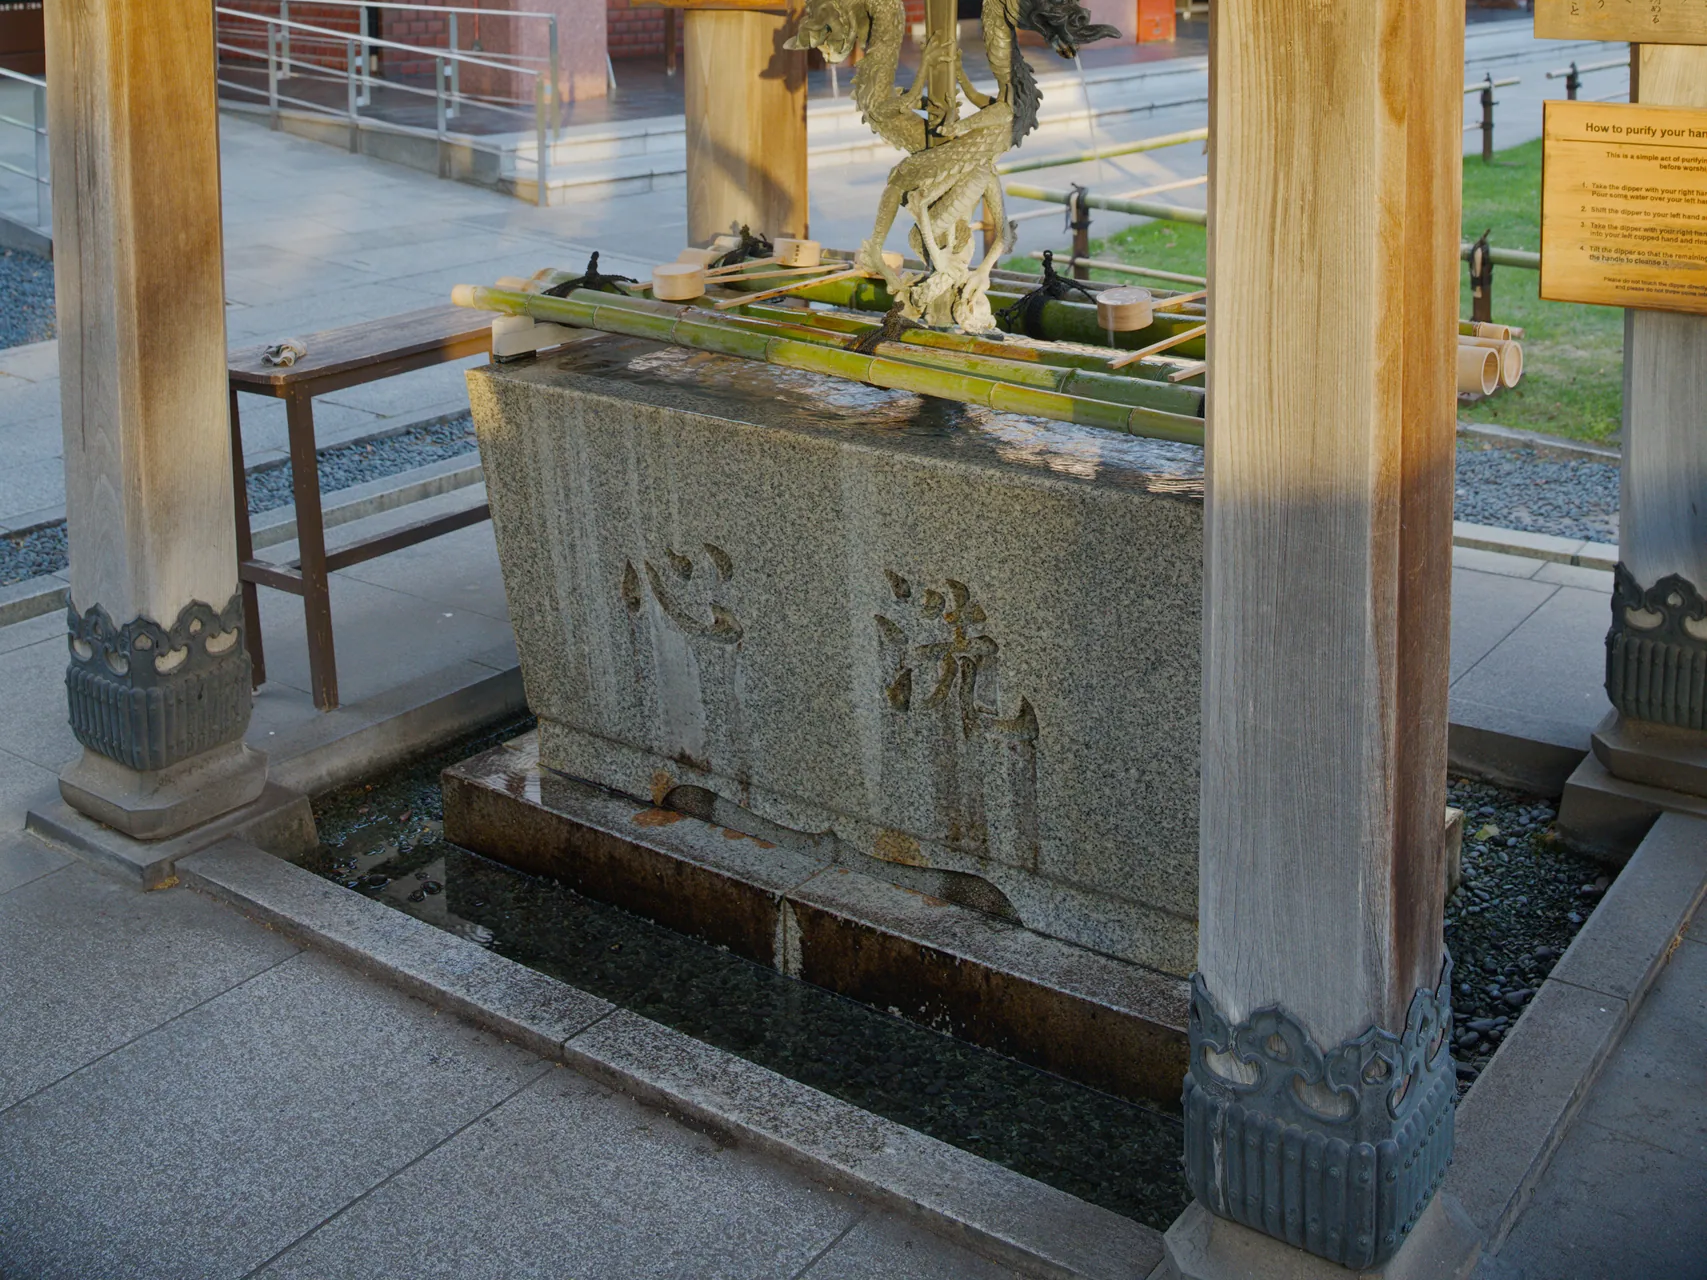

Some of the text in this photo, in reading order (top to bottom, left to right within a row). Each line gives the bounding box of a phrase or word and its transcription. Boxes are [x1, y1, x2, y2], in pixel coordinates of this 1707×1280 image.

[1586, 123, 1609, 133] How
[1612, 125, 1623, 133] to
[1626, 125, 1657, 137] purify
[1660, 128, 1685, 138] your
[1636, 153, 1658, 162] simple
[1661, 188, 1676, 196] your
[1621, 208, 1642, 216] dipper
[1620, 224, 1641, 232] dipper
[1634, 234, 1659, 242] cupped
[1614, 248, 1636, 256] dipper
[1601, 255, 1624, 263] handle
